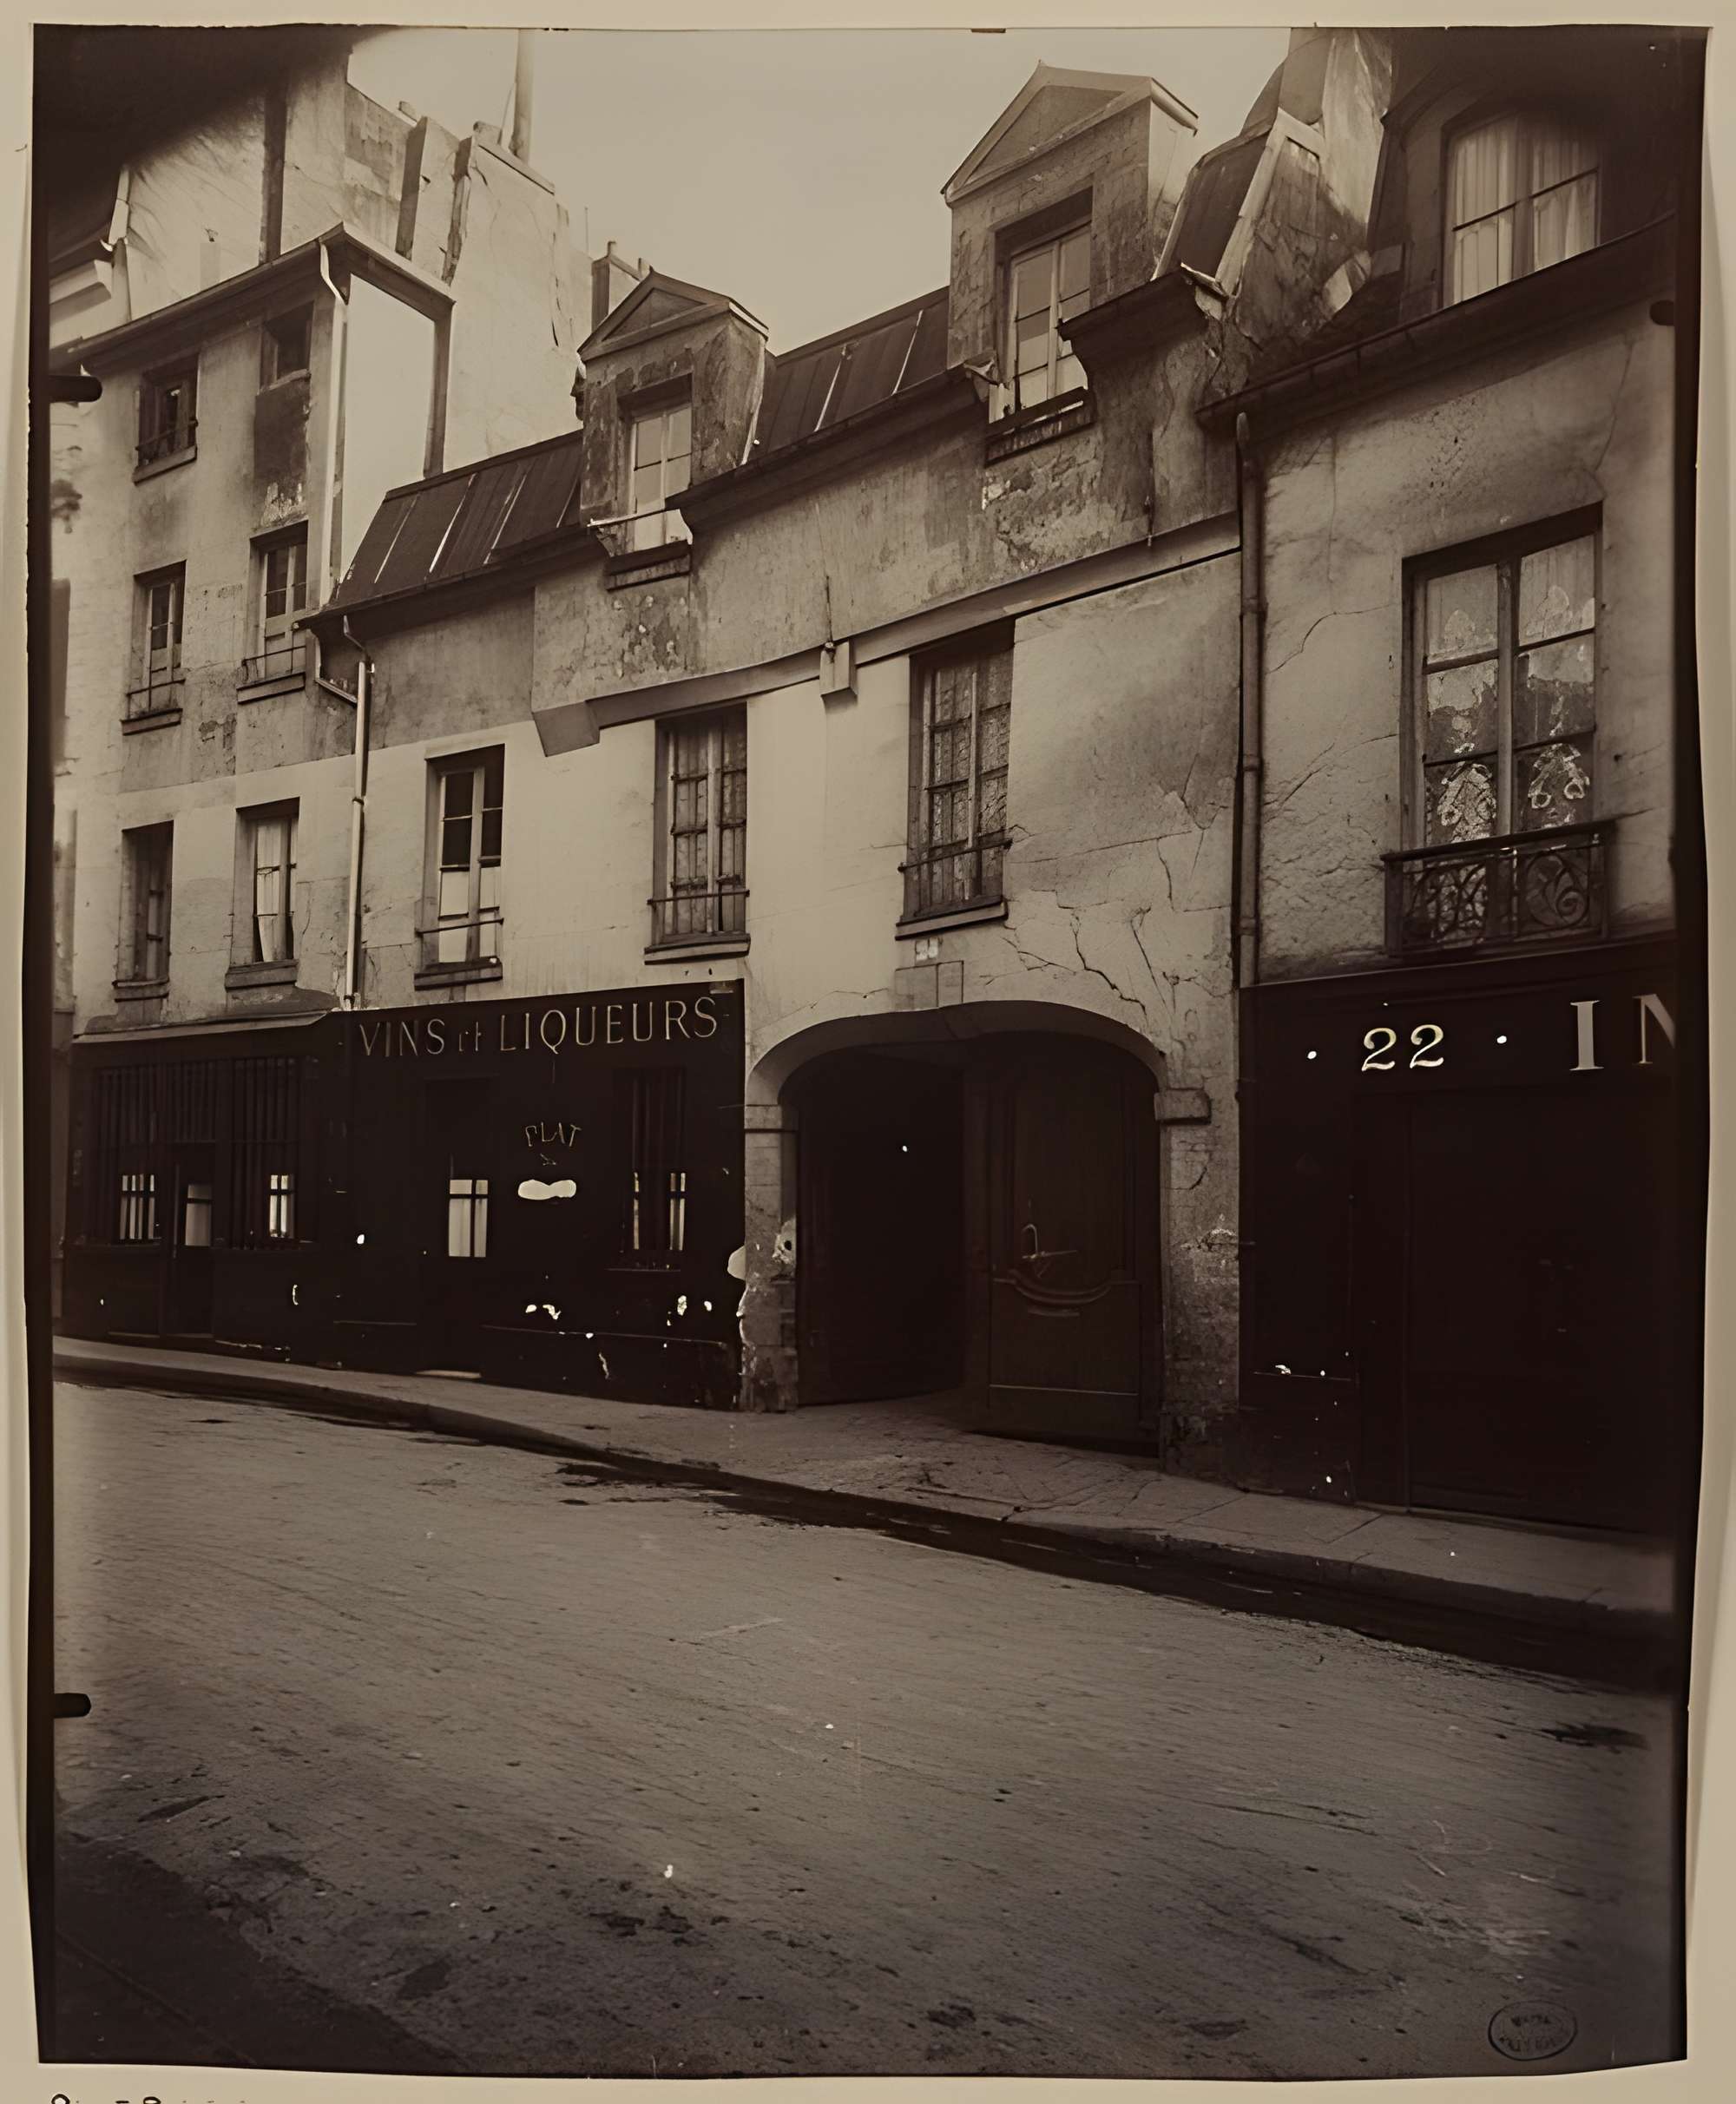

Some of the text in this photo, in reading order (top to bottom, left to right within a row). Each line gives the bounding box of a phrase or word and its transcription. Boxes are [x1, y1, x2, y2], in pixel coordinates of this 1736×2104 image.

[359, 1018, 446, 1057] VINS
[500, 996, 717, 1055] LIQUEURS
[1361, 1024, 1444, 1071] 22
